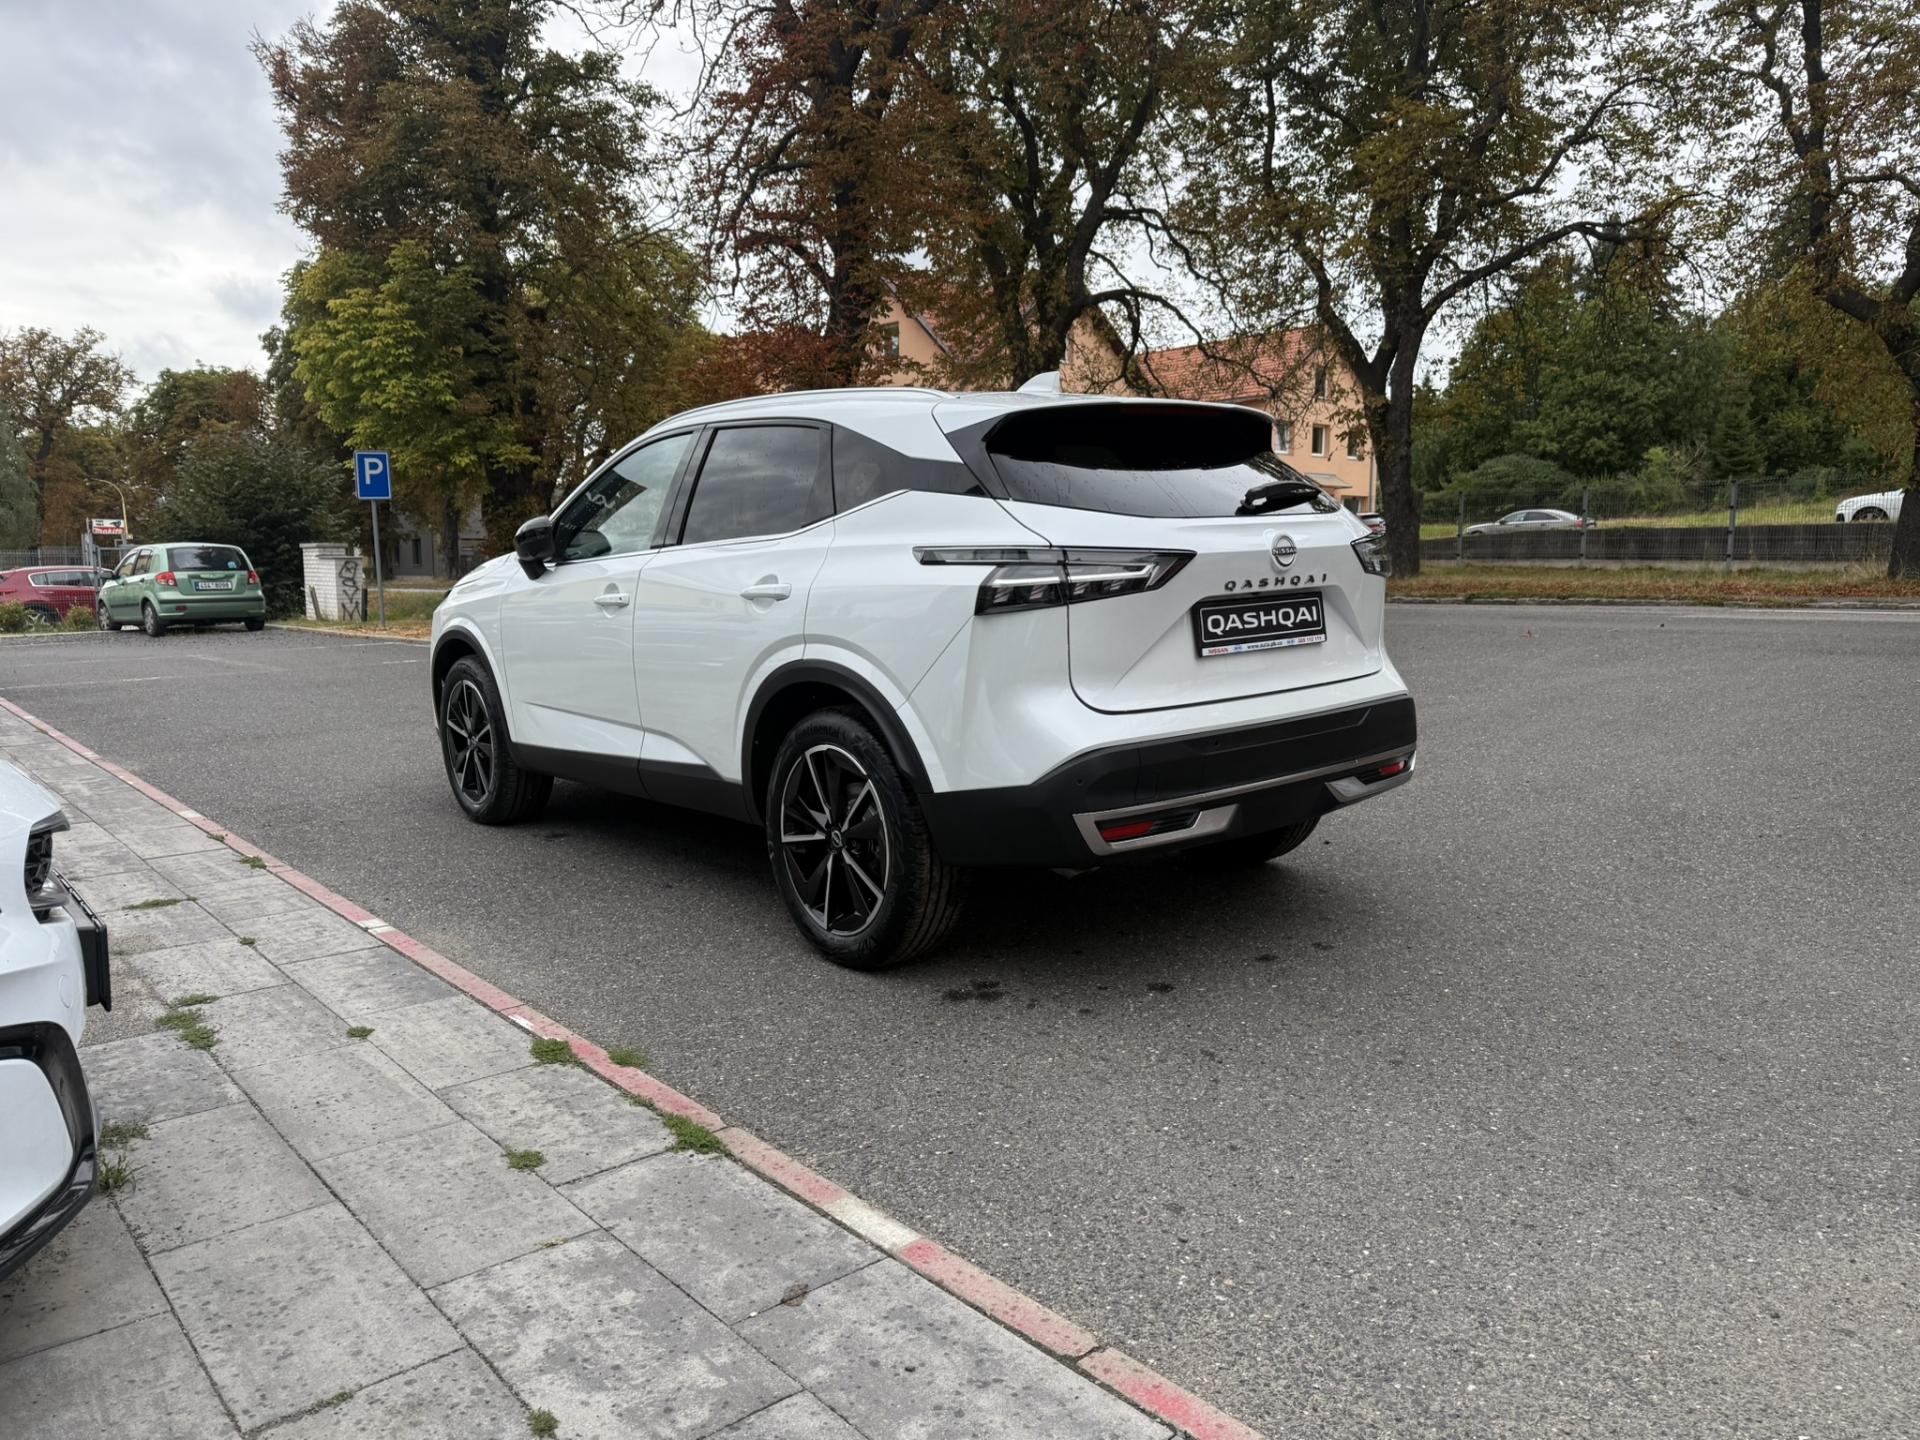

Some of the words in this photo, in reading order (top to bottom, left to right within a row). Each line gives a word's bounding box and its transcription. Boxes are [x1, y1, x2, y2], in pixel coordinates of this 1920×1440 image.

[364, 457, 383, 485] P
[1224, 573, 1327, 592] QASHQAI
[1207, 606, 1318, 636] QASHQAI
